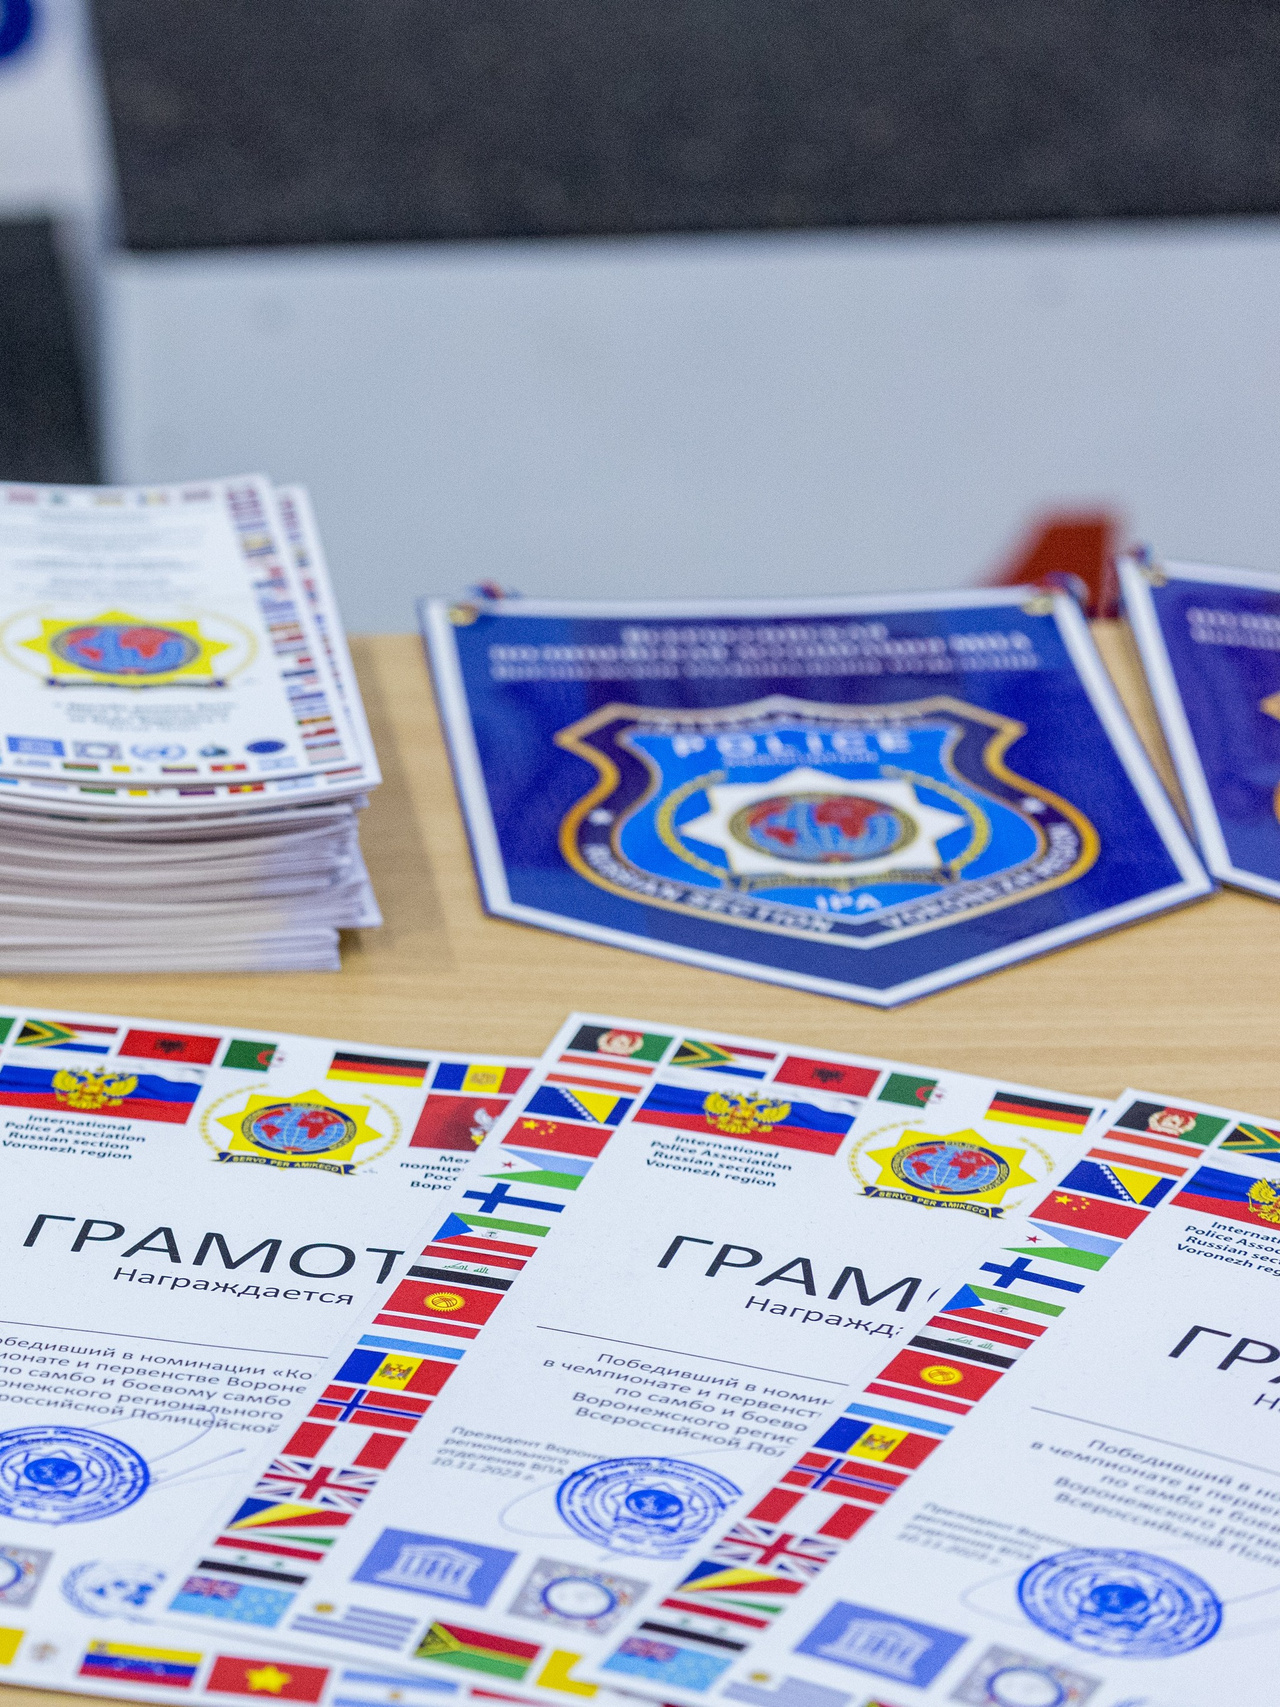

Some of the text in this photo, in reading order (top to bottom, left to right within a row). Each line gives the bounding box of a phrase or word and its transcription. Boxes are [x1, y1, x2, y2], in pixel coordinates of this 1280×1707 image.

[672, 729, 912, 758] POLICE
[815, 891, 883, 912] IPA
[5, 1121, 146, 1142] Police Association
[28, 1114, 131, 1131] International
[2, 1140, 132, 1159] Voronezh region
[9, 1132, 130, 1150] Russian section
[675, 1135, 779, 1159] International
[232, 1156, 339, 1172] SERVO PER AMIKECO
[400, 1162, 464, 1173] полице
[651, 1141, 792, 1171] Police Association
[654, 1152, 775, 1177] Russian section
[645, 1159, 777, 1187] Voronezh region
[879, 1191, 987, 1215] SERVO PER AMIKECO
[1185, 1226, 1233, 1242] Police
[1186, 1236, 1247, 1256] Russian
[23, 1213, 406, 1285] ГРАМОТ
[1178, 1244, 1253, 1267] Voronezh
[113, 1267, 354, 1306] Награждается
[657, 1236, 940, 1312] ГРАМ
[745, 1296, 904, 1338] Награжд
[123, 1352, 134, 1360] в
[140, 1354, 265, 1375] номинации
[1169, 1325, 1280, 1384] ГР
[97, 1363, 220, 1384] первенстве
[598, 1353, 746, 1389] Победивший
[746, 1383, 757, 1392] в
[29, 1369, 95, 1384] самбо
[103, 1378, 115, 1387] и
[122, 1379, 218, 1400] боевому
[223, 1393, 291, 1406] самбо
[543, 1360, 822, 1418] в чемпионате и первенст
[118, 1394, 284, 1420] регионального
[572, 1391, 730, 1432] Воронежского
[615, 1388, 808, 1432] по самбо и боево
[575, 1407, 746, 1449] Всероссийской
